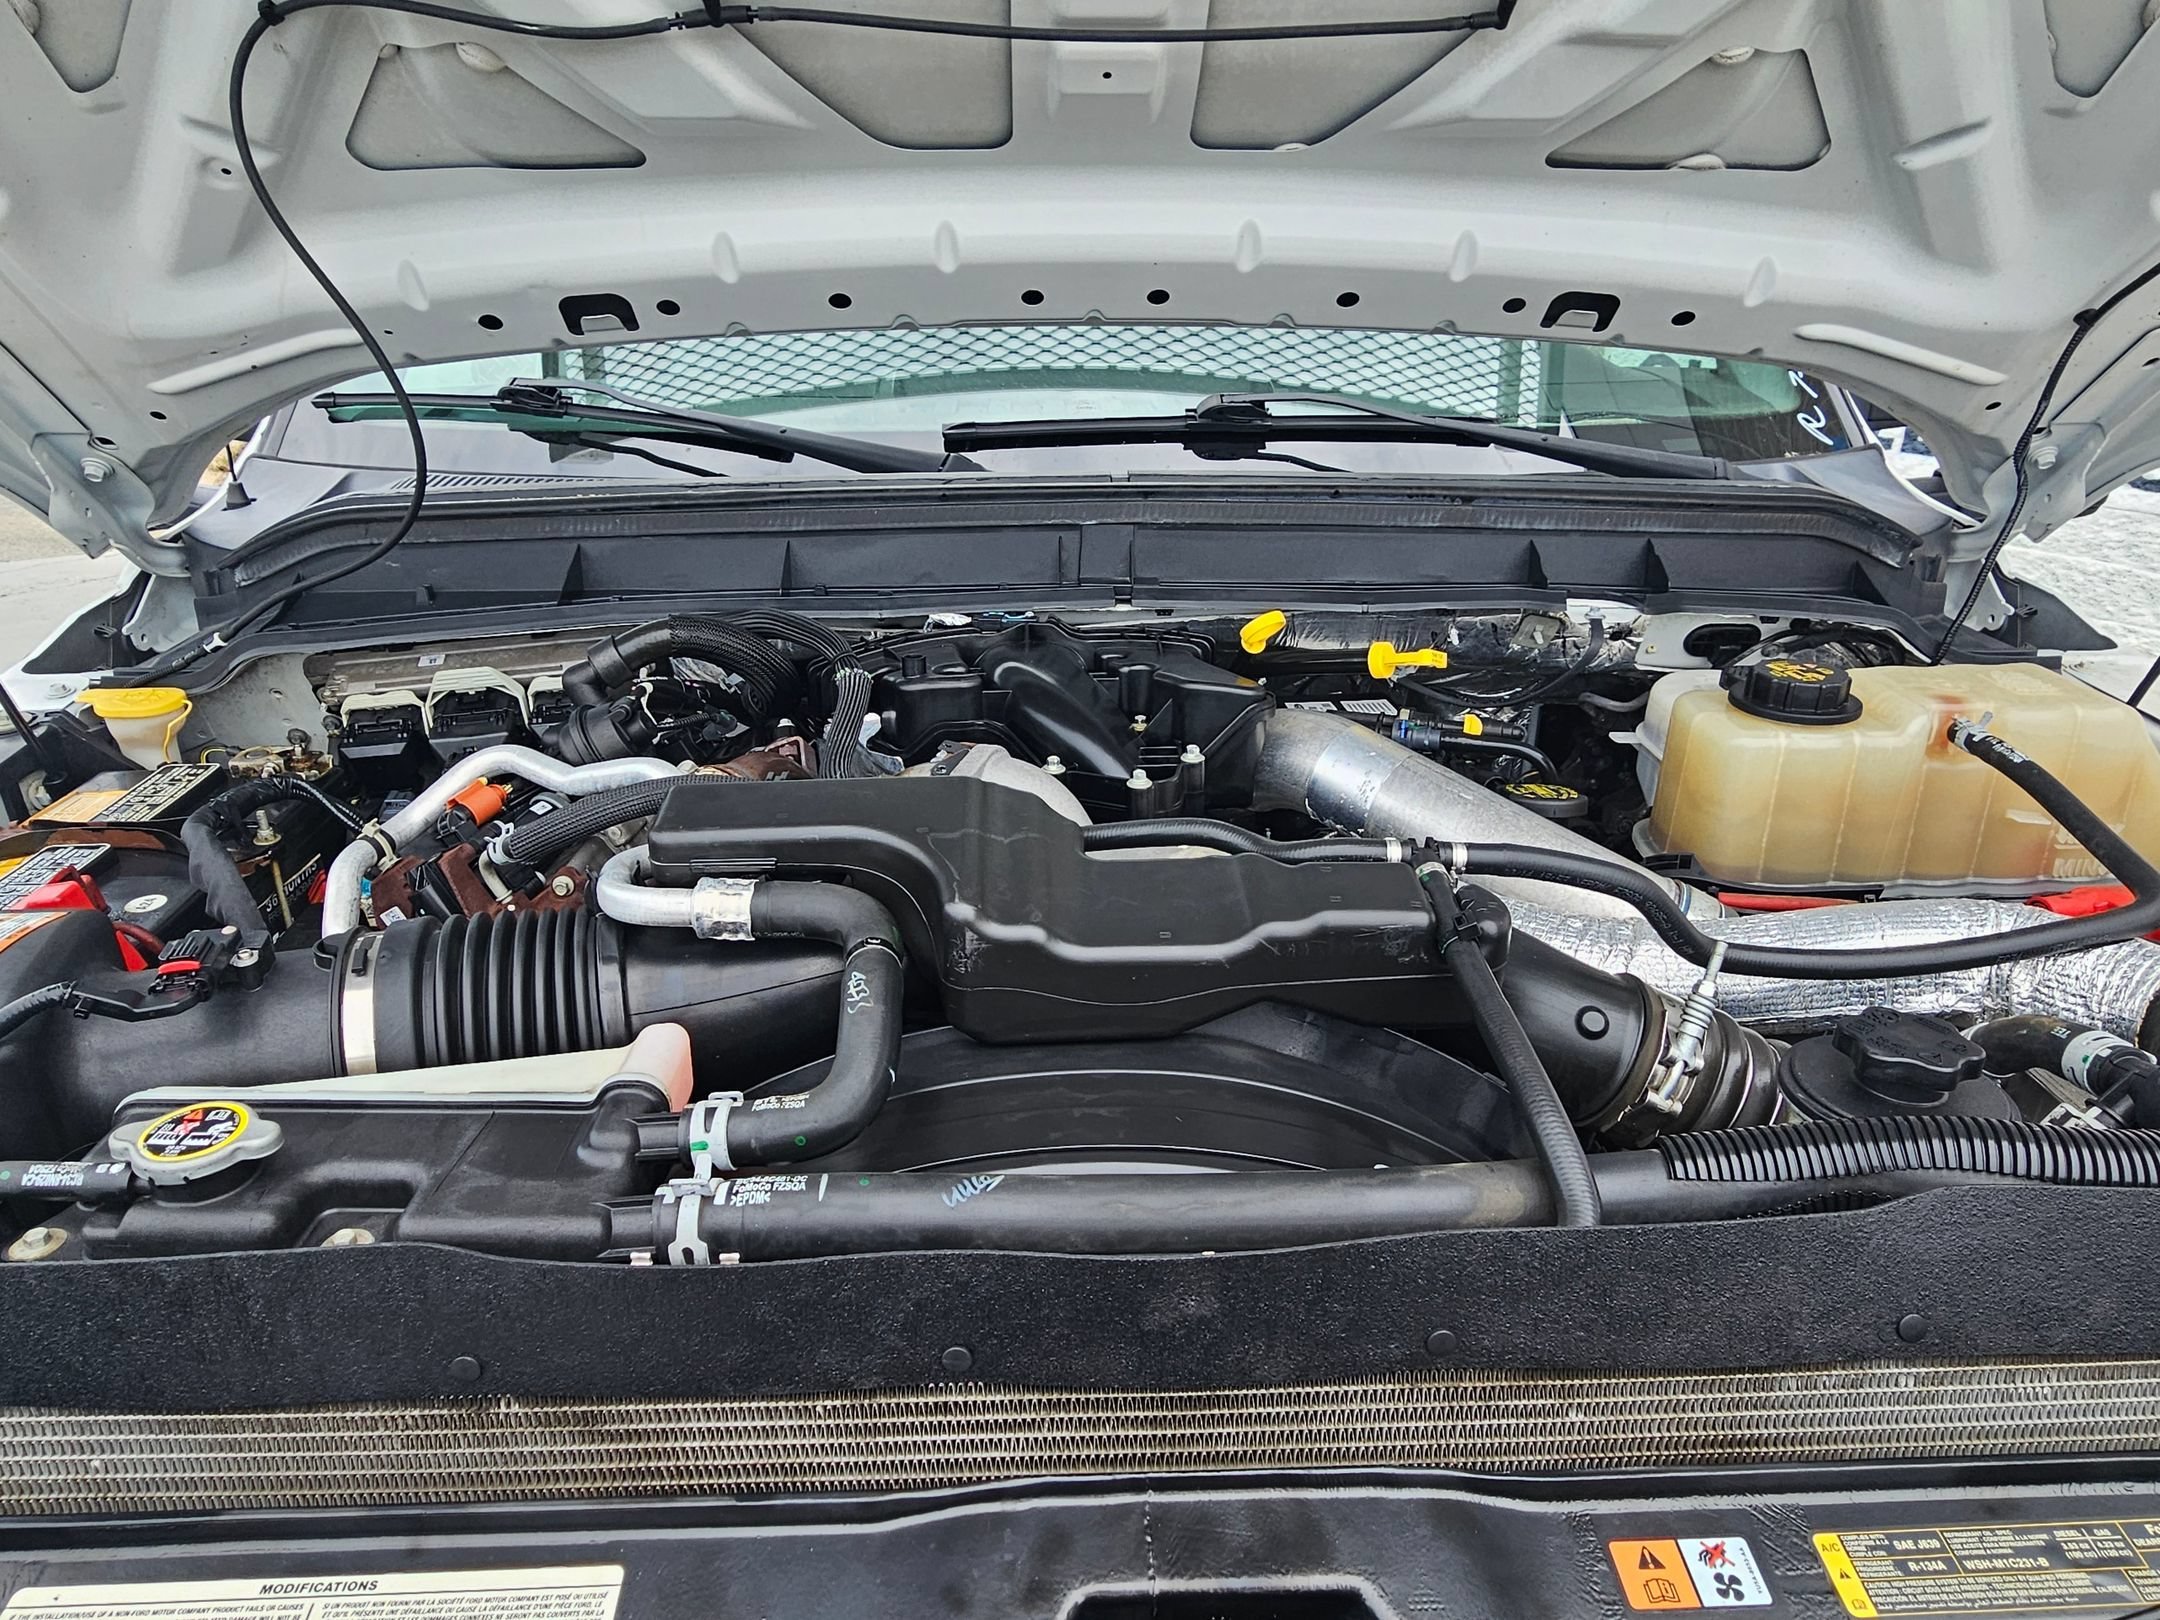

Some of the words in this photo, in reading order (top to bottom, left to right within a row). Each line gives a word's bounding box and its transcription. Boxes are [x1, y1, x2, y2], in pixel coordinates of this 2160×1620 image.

[732, 1183, 772, 1194] FoMoCo
[772, 1181, 806, 1191] FZSQA
[2053, 1530, 2082, 1538] DIESEL
[2093, 1528, 2112, 1536] GAS
[1820, 1542, 1841, 1553] A/C
[1892, 1539, 1917, 1550] SAE
[1907, 1560, 1948, 1572] R-134A
[1962, 1557, 2050, 1571] WSH-M1C231-B
[259, 1580, 379, 1595] MODIFICATIONS
